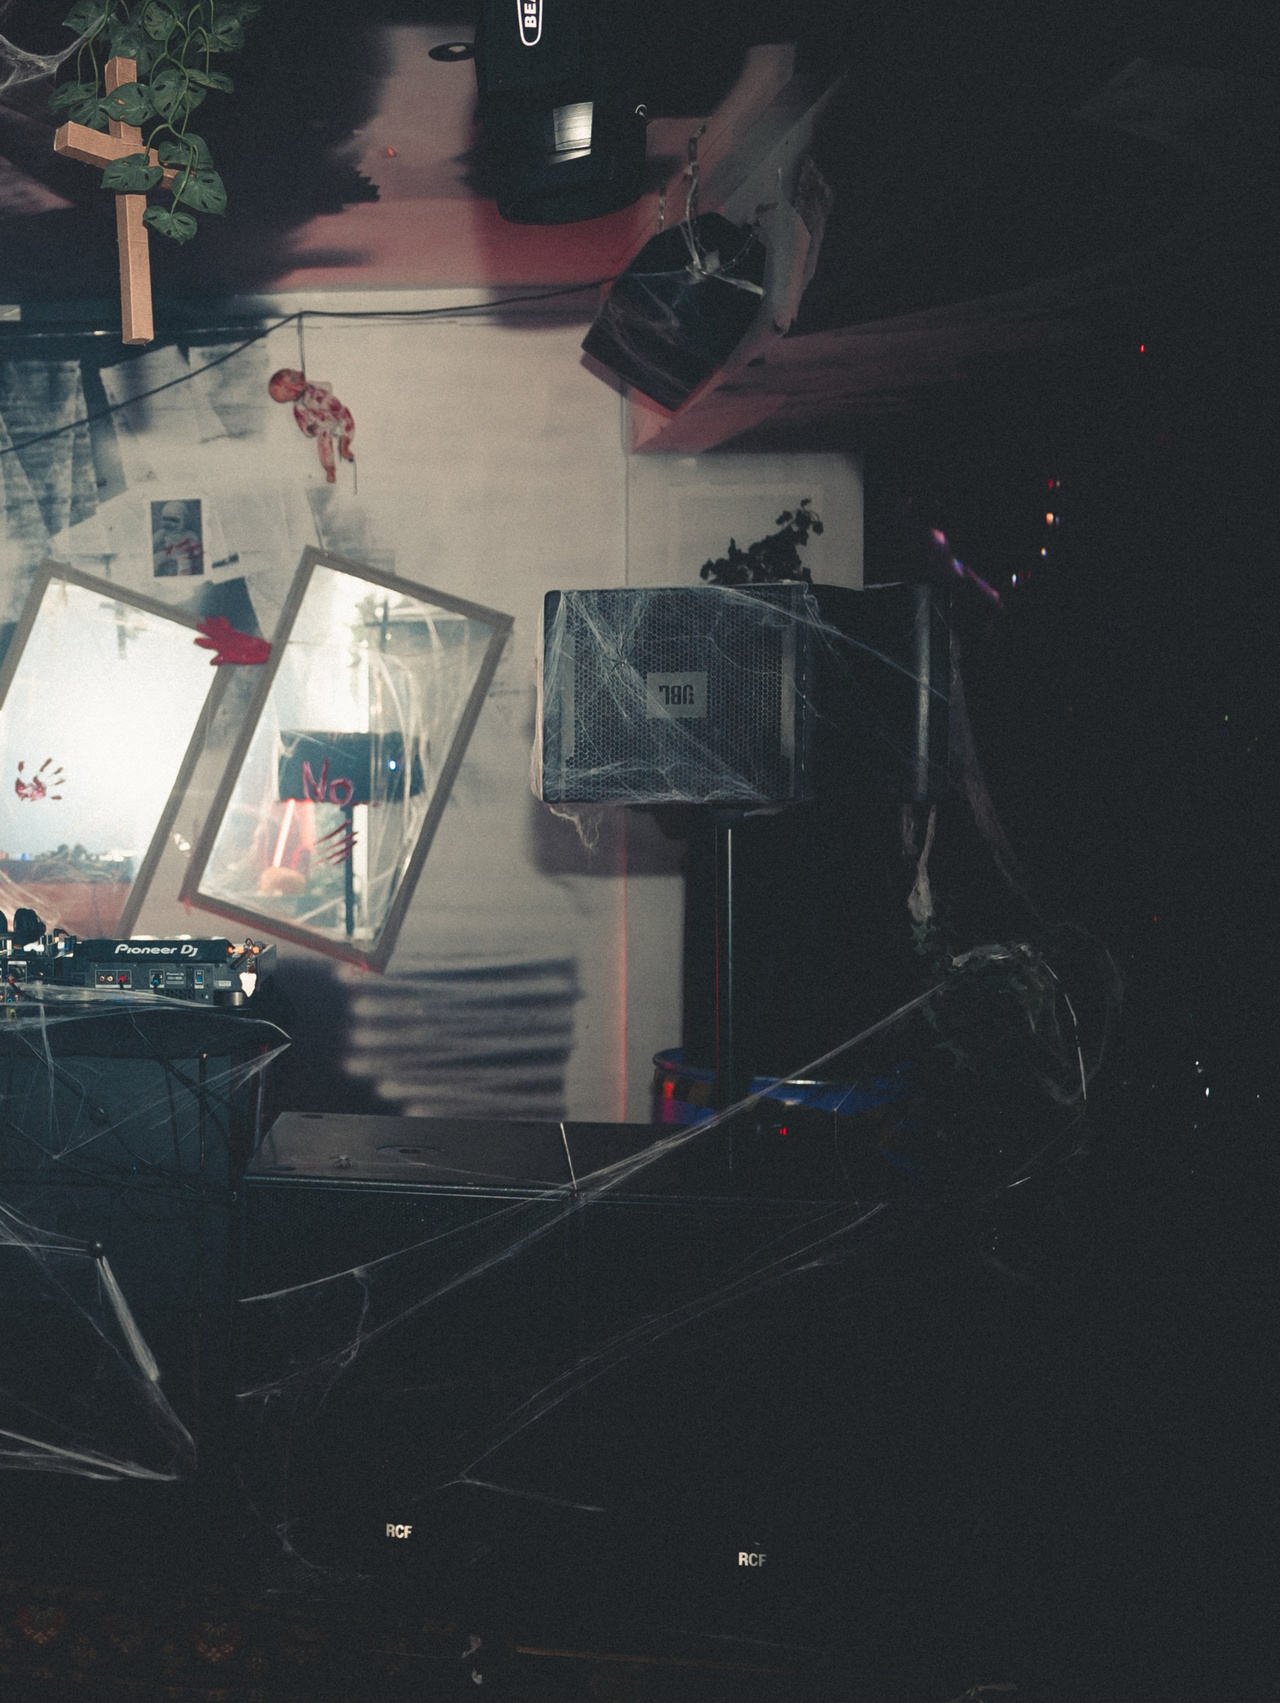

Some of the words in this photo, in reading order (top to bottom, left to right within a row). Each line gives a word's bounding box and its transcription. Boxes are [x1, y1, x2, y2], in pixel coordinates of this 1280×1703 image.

[523, 0, 537, 28] BE
[658, 684, 695, 705] JBL
[302, 757, 354, 807] No
[114, 943, 177, 955] Pioneer
[385, 1523, 413, 1539] RCF
[738, 1551, 767, 1567] RCF
